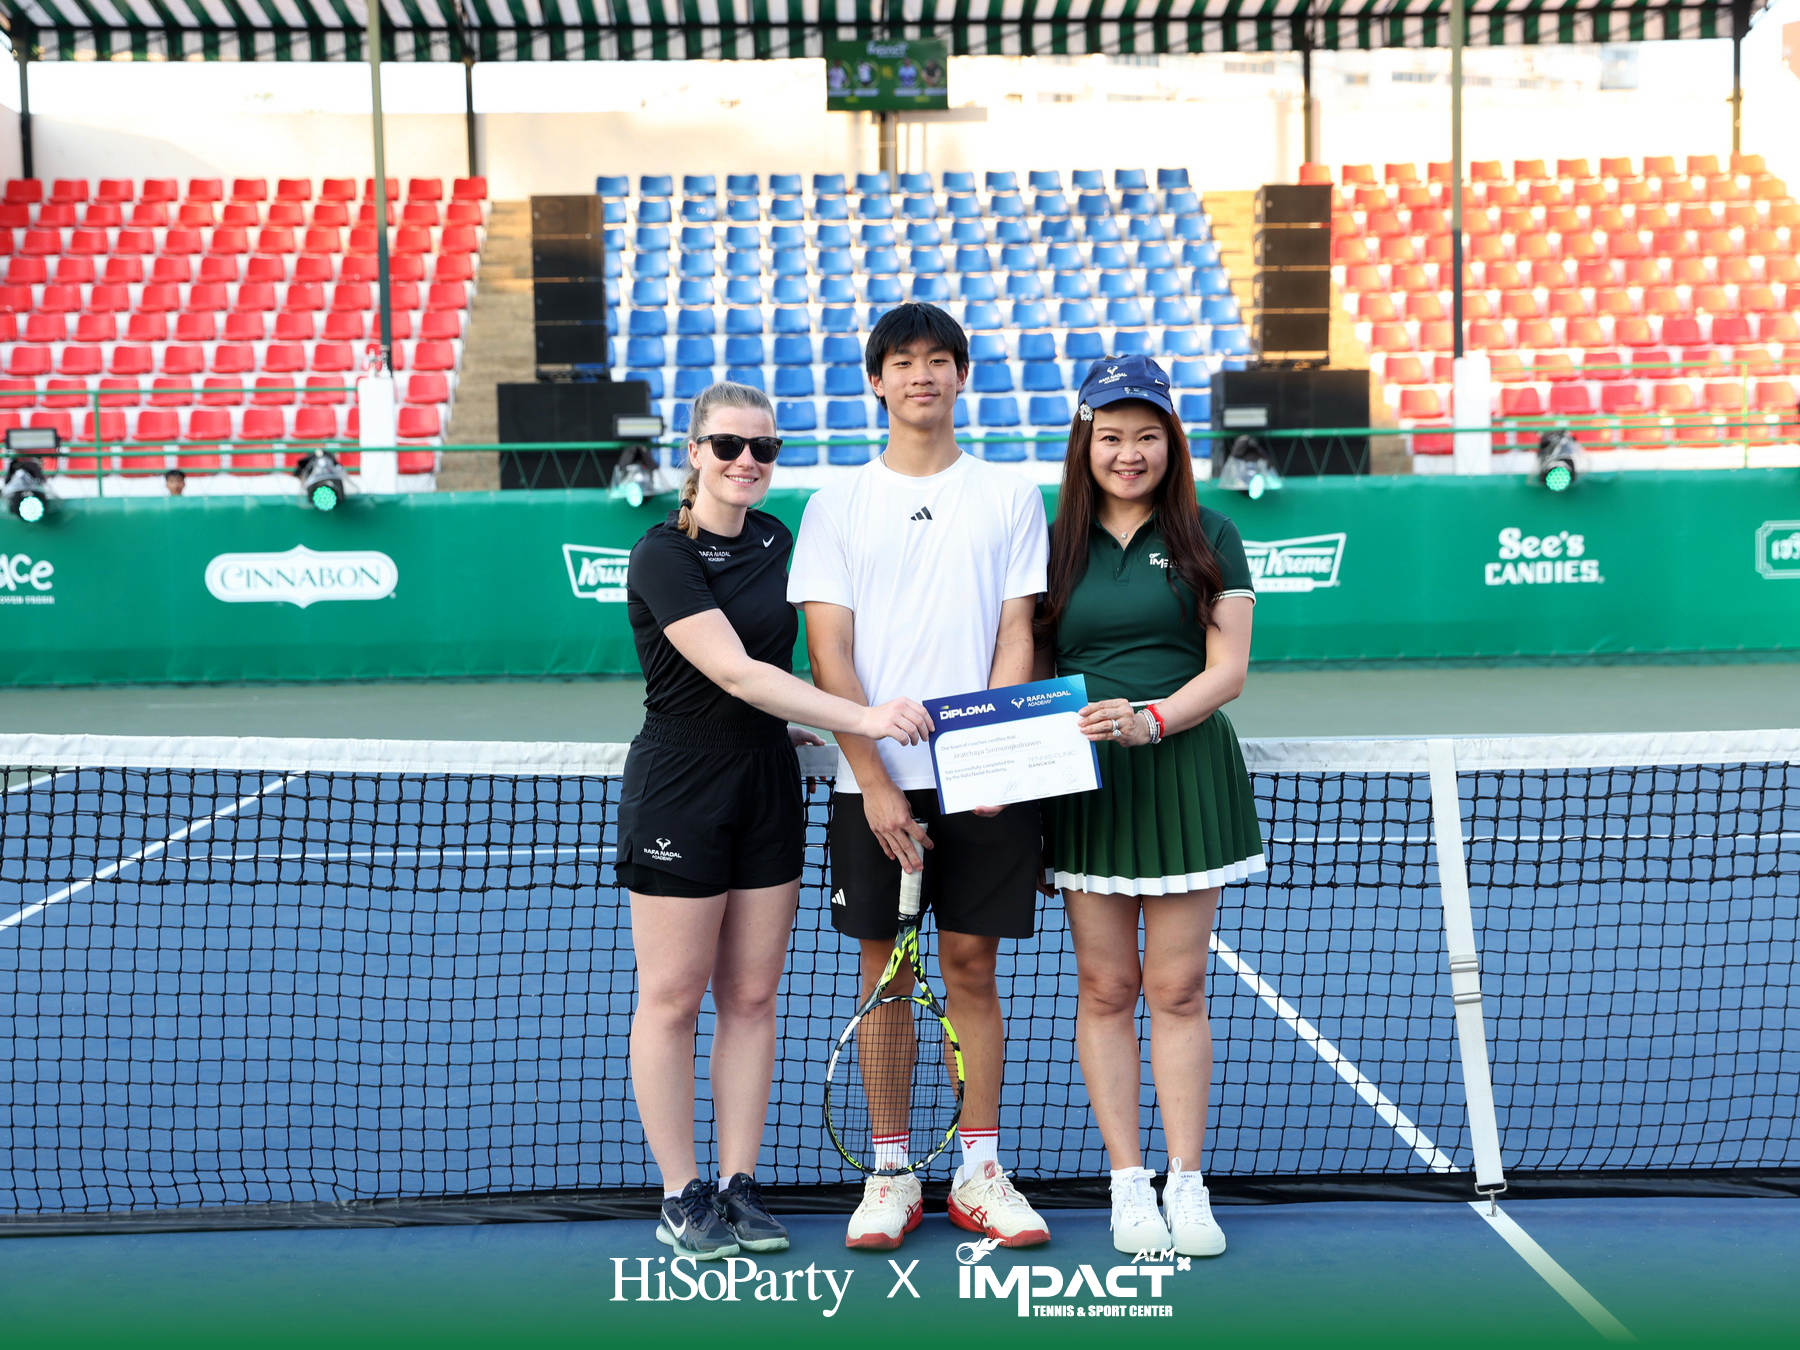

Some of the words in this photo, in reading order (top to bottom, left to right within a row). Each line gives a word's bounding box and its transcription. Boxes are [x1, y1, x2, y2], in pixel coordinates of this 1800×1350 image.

[1498, 527, 1585, 559] See's
[220, 565, 381, 592] CINNABON
[1484, 560, 1600, 586] CANDIES
[1027, 699, 1052, 708] ACADEMY
[1046, 690, 1071, 699] NADAL
[939, 703, 996, 720] DIPLOMA
